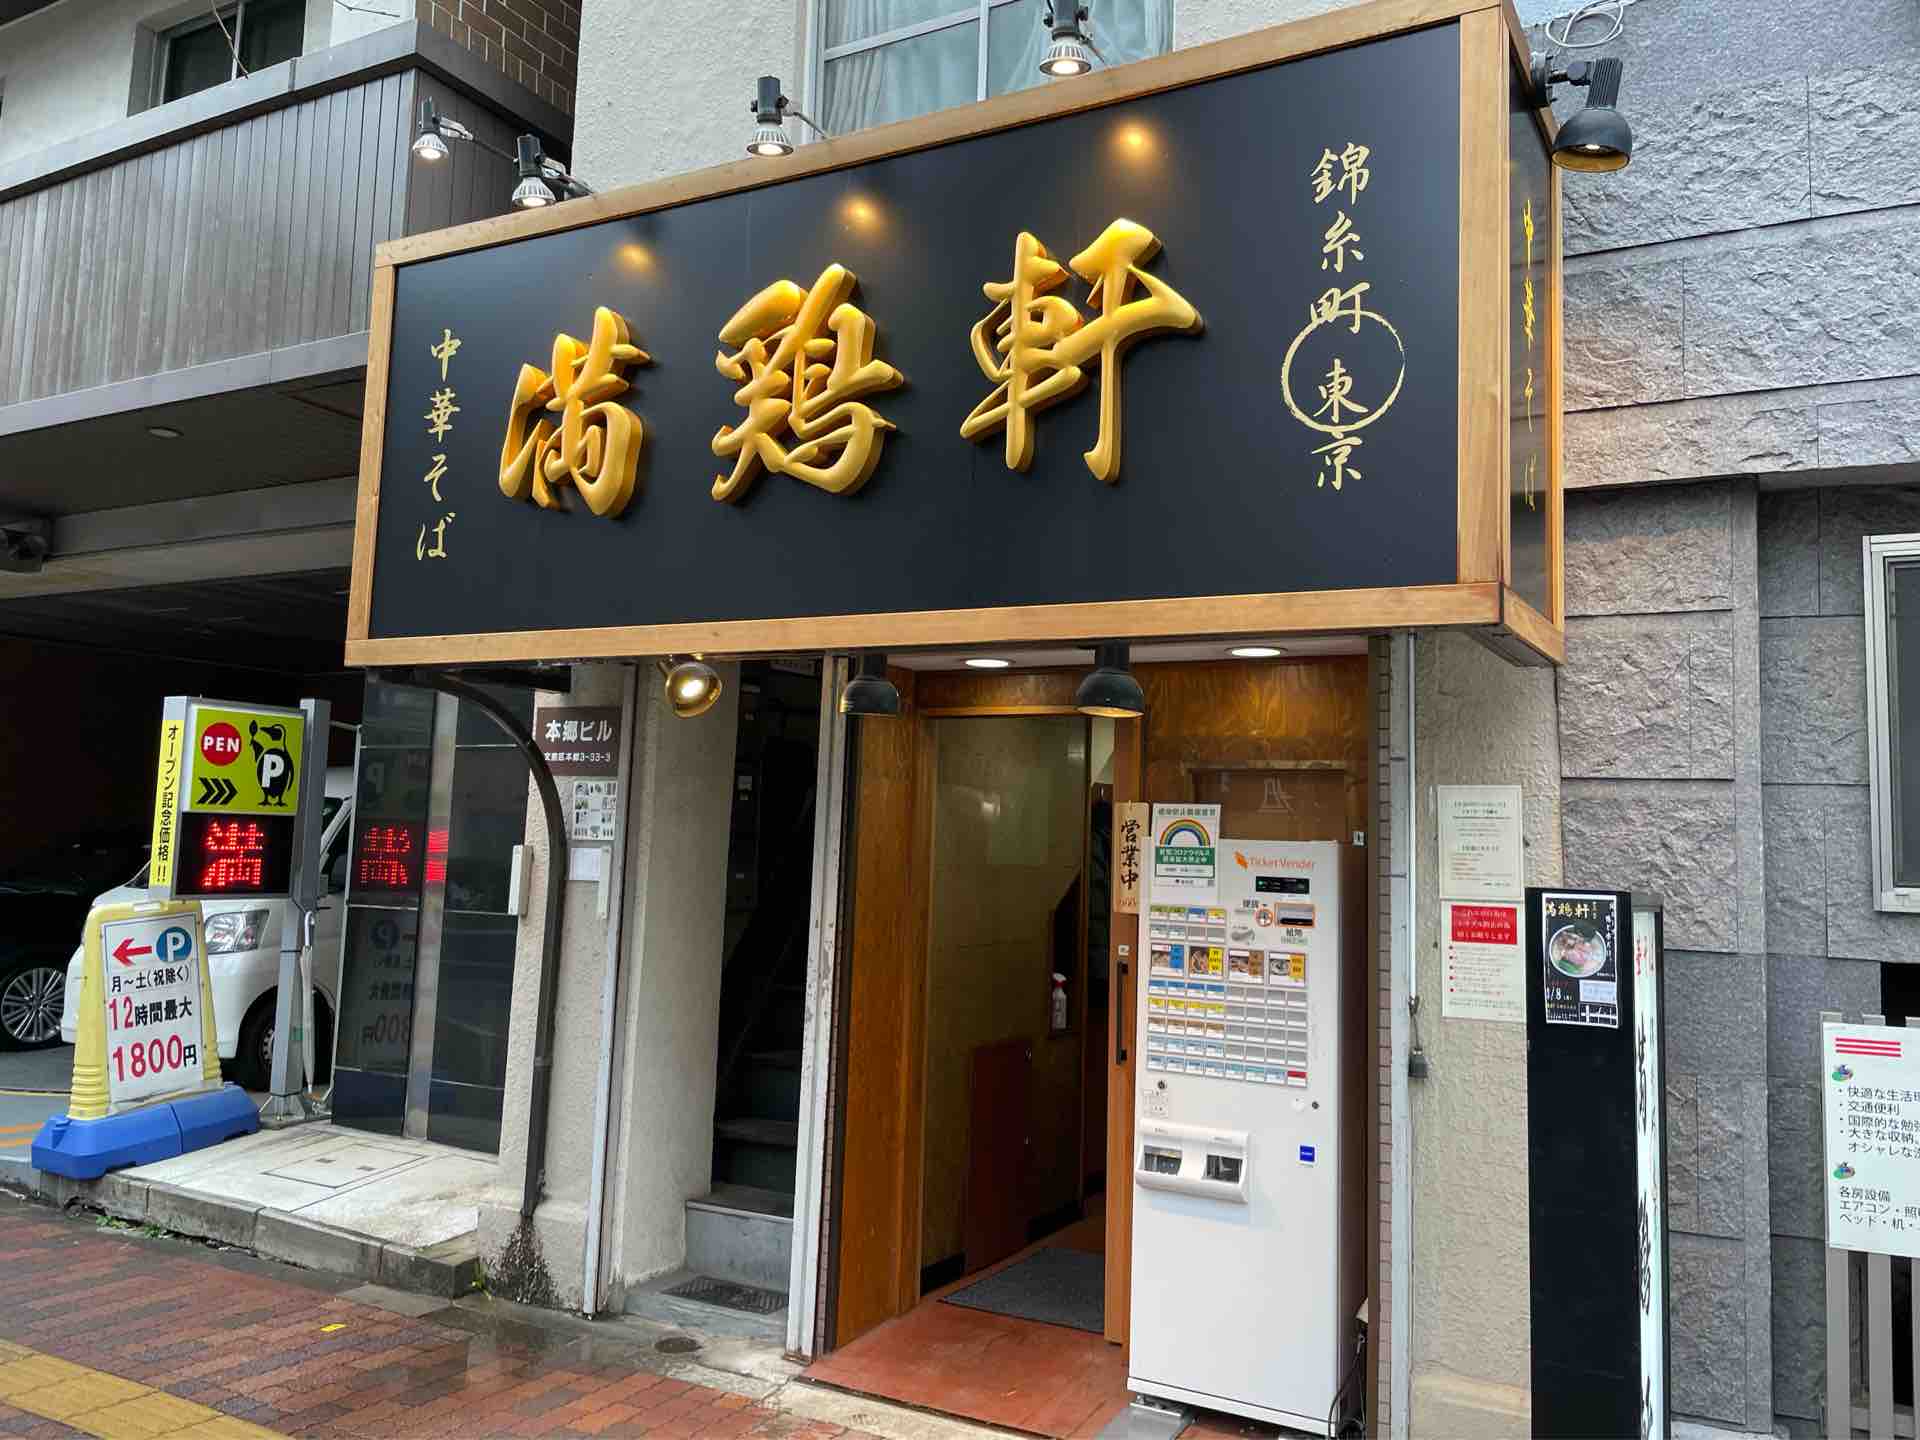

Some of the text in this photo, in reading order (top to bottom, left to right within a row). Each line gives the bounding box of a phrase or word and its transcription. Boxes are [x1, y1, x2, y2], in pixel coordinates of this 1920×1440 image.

[415, 328, 462, 561] 中華そば
[203, 735, 240, 753] PEN
[545, 719, 613, 743] 本郷ビル
[262, 753, 285, 788] P
[202, 821, 265, 887] 満
[1120, 818, 1141, 891] 営業中
[166, 932, 186, 963] P
[109, 996, 193, 1030] 12時間最大
[113, 1034, 198, 1082] 1800円
[1848, 1101, 1900, 1116] 交通便利
[1839, 1186, 1891, 1203] 各房設備
[1839, 1200, 1920, 1218] エアコン・照
